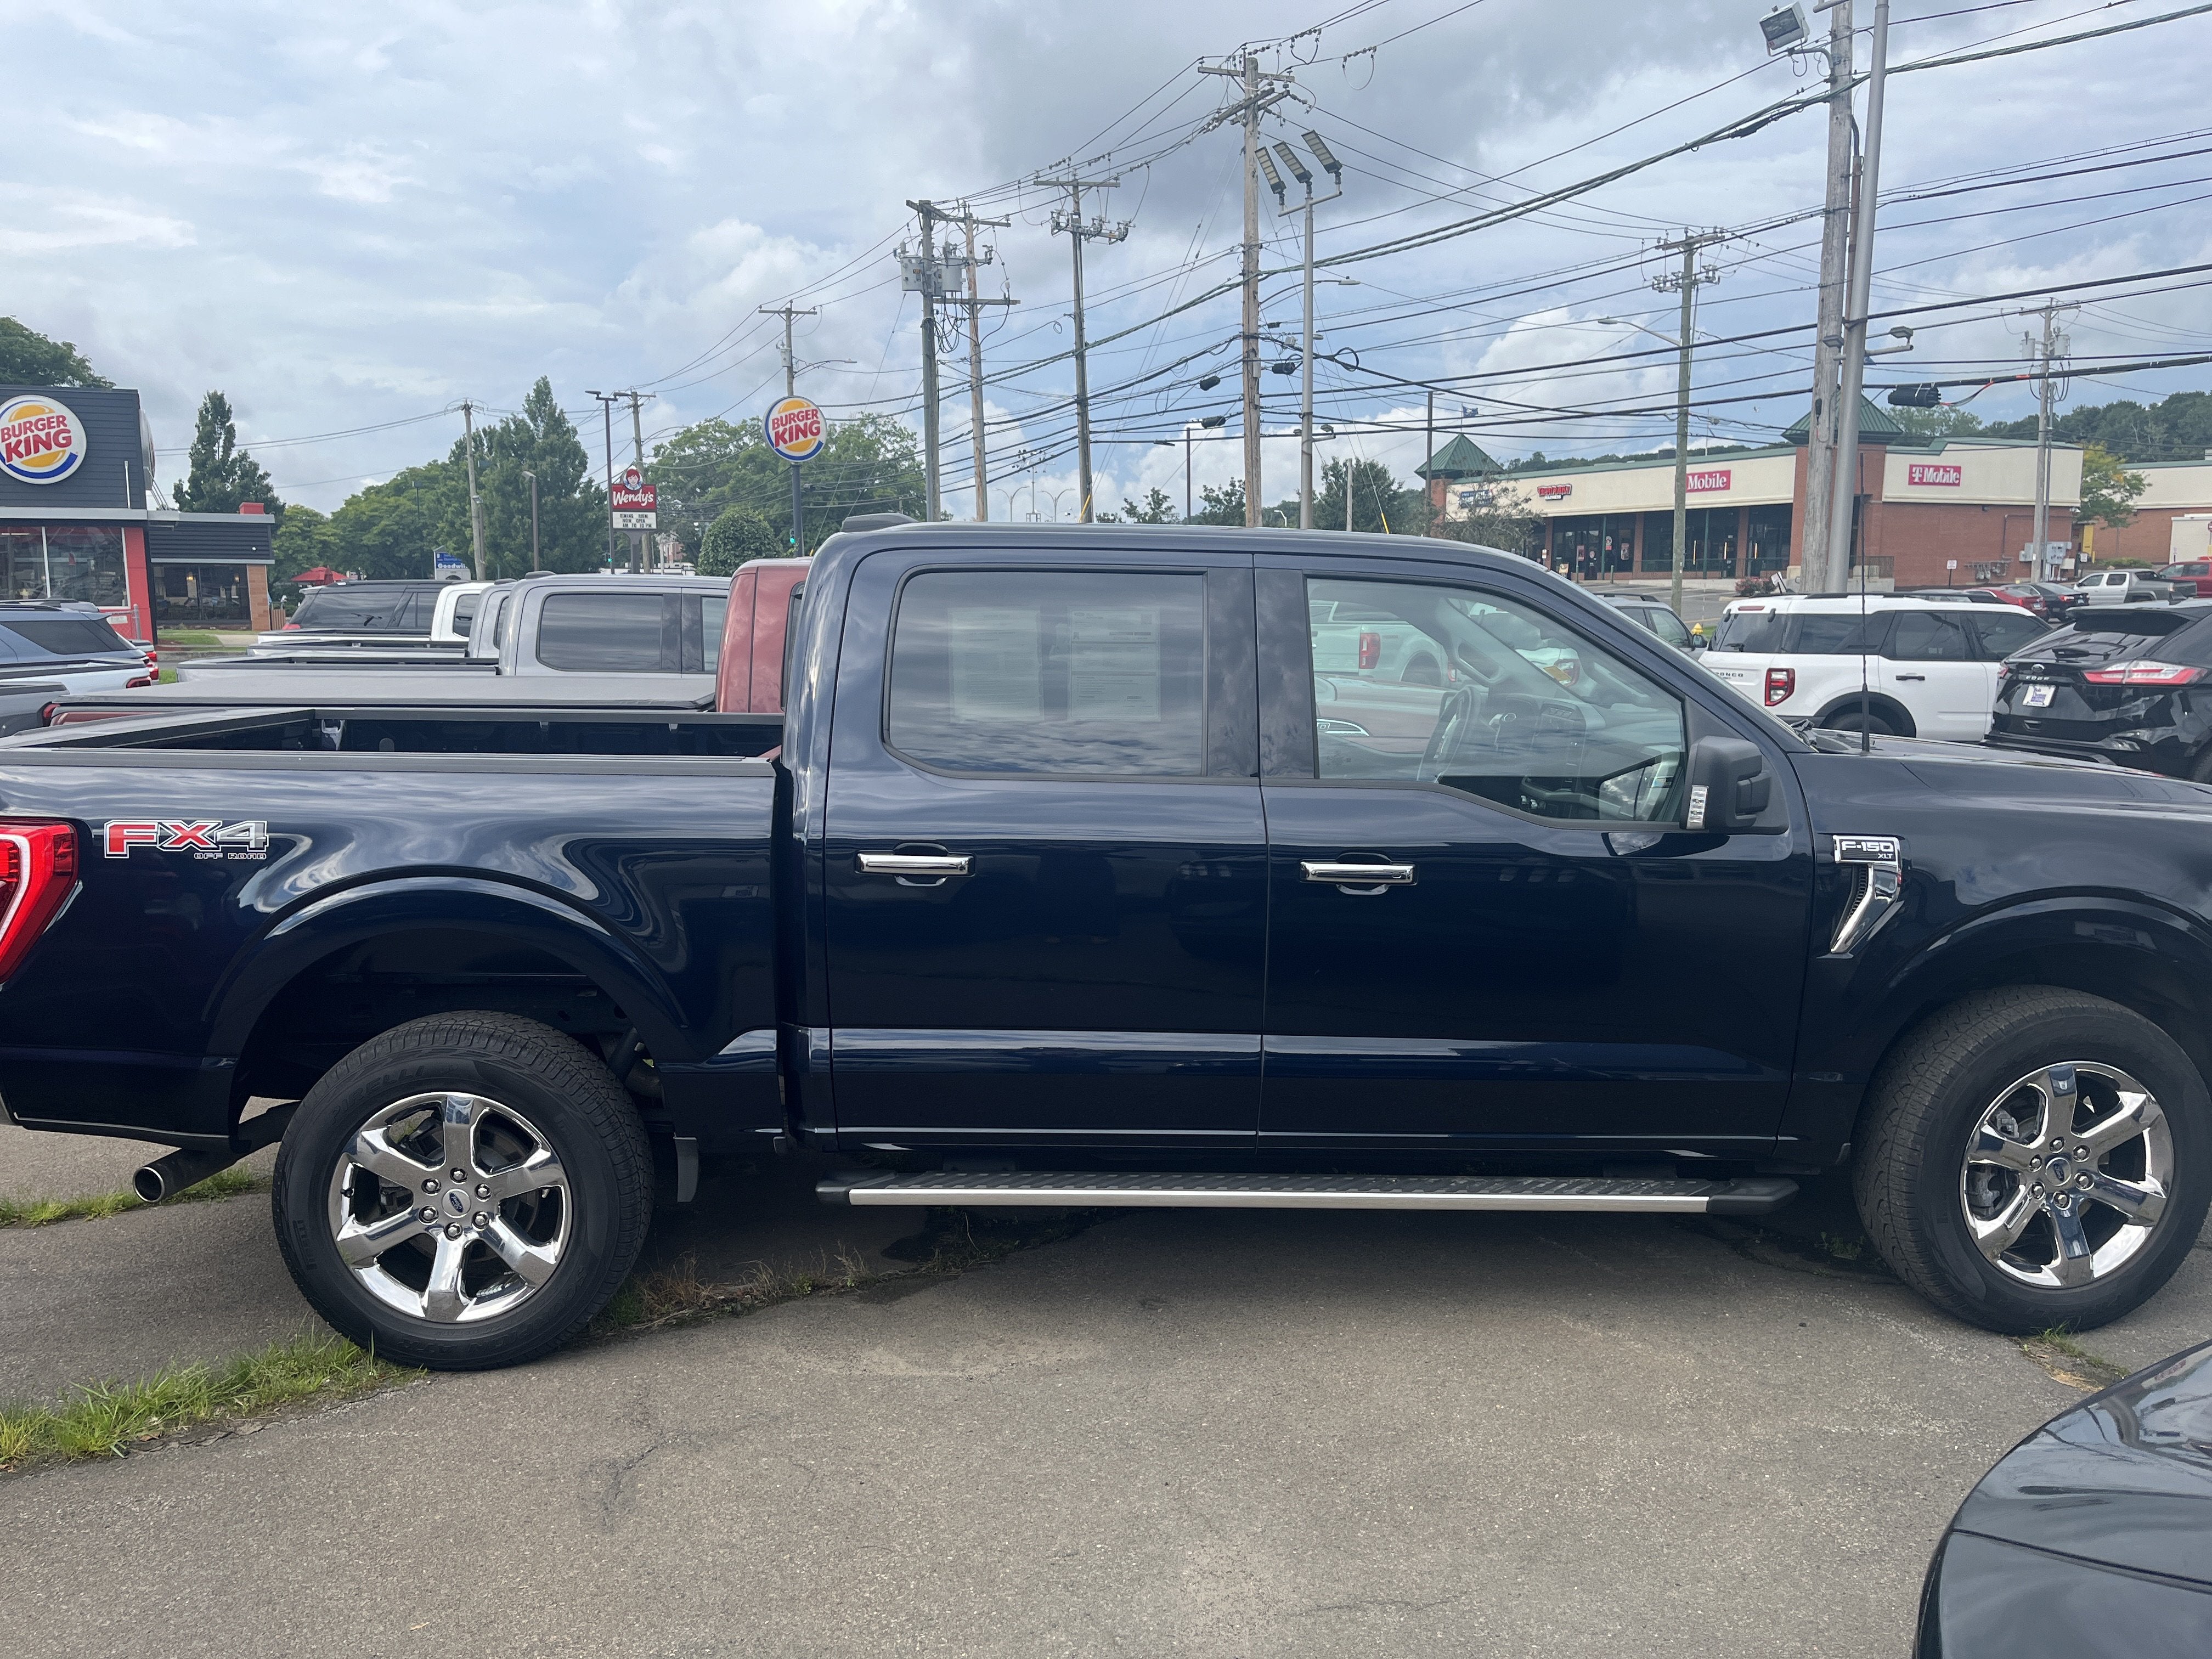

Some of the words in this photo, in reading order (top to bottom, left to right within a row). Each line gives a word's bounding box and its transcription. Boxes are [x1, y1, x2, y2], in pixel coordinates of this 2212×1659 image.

[1, 415, 67, 443] BURGER
[772, 409, 819, 431] BURGER
[5, 428, 72, 463] KING
[775, 420, 820, 448] KING
[1688, 473, 1726, 490] Mobile
[613, 489, 654, 506] Wendy's
[104, 820, 269, 858] FX4
[1841, 840, 1893, 851] F-150
